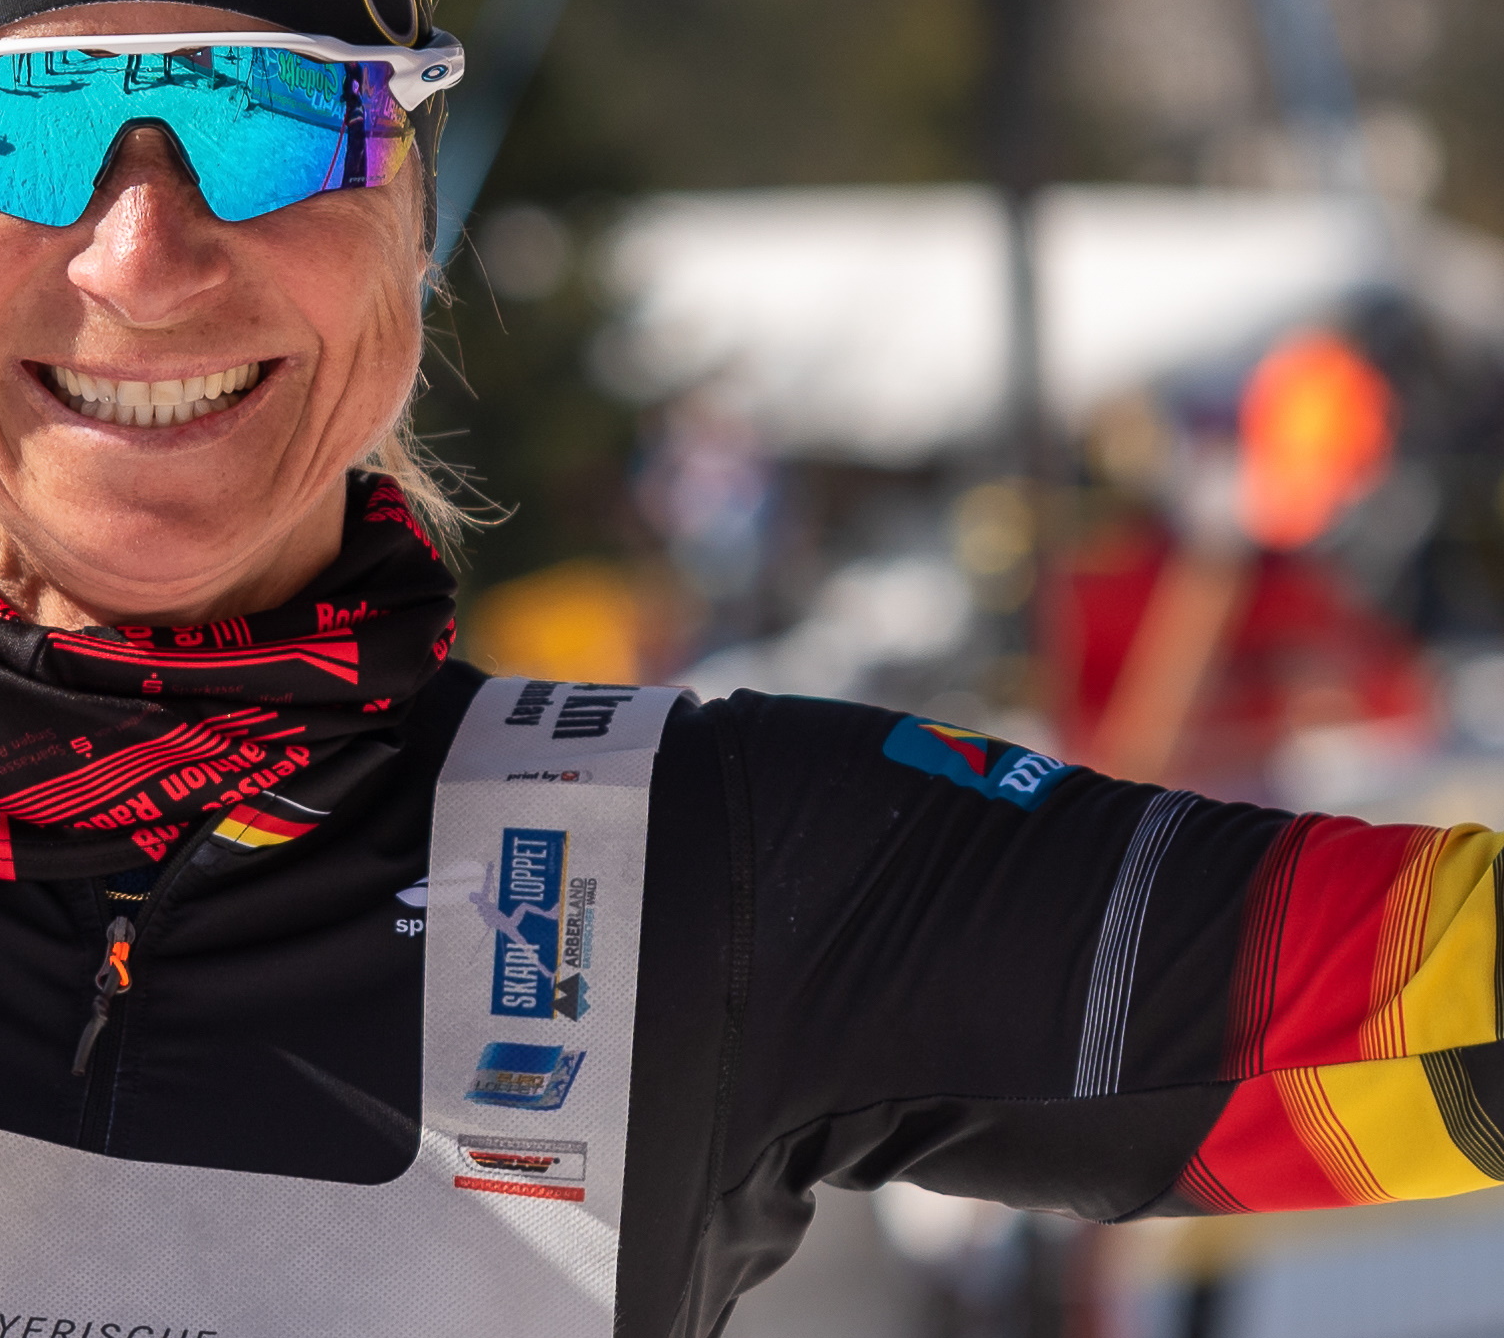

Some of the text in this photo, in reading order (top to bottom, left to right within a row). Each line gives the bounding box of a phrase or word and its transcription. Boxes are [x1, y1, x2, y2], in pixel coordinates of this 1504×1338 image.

[506, 771, 540, 781] print
[541, 771, 560, 782] by
[586, 877, 598, 905] WALD
[503, 836, 549, 1010] SKADI LOPPET
[565, 876, 585, 969] ARBERLAND
